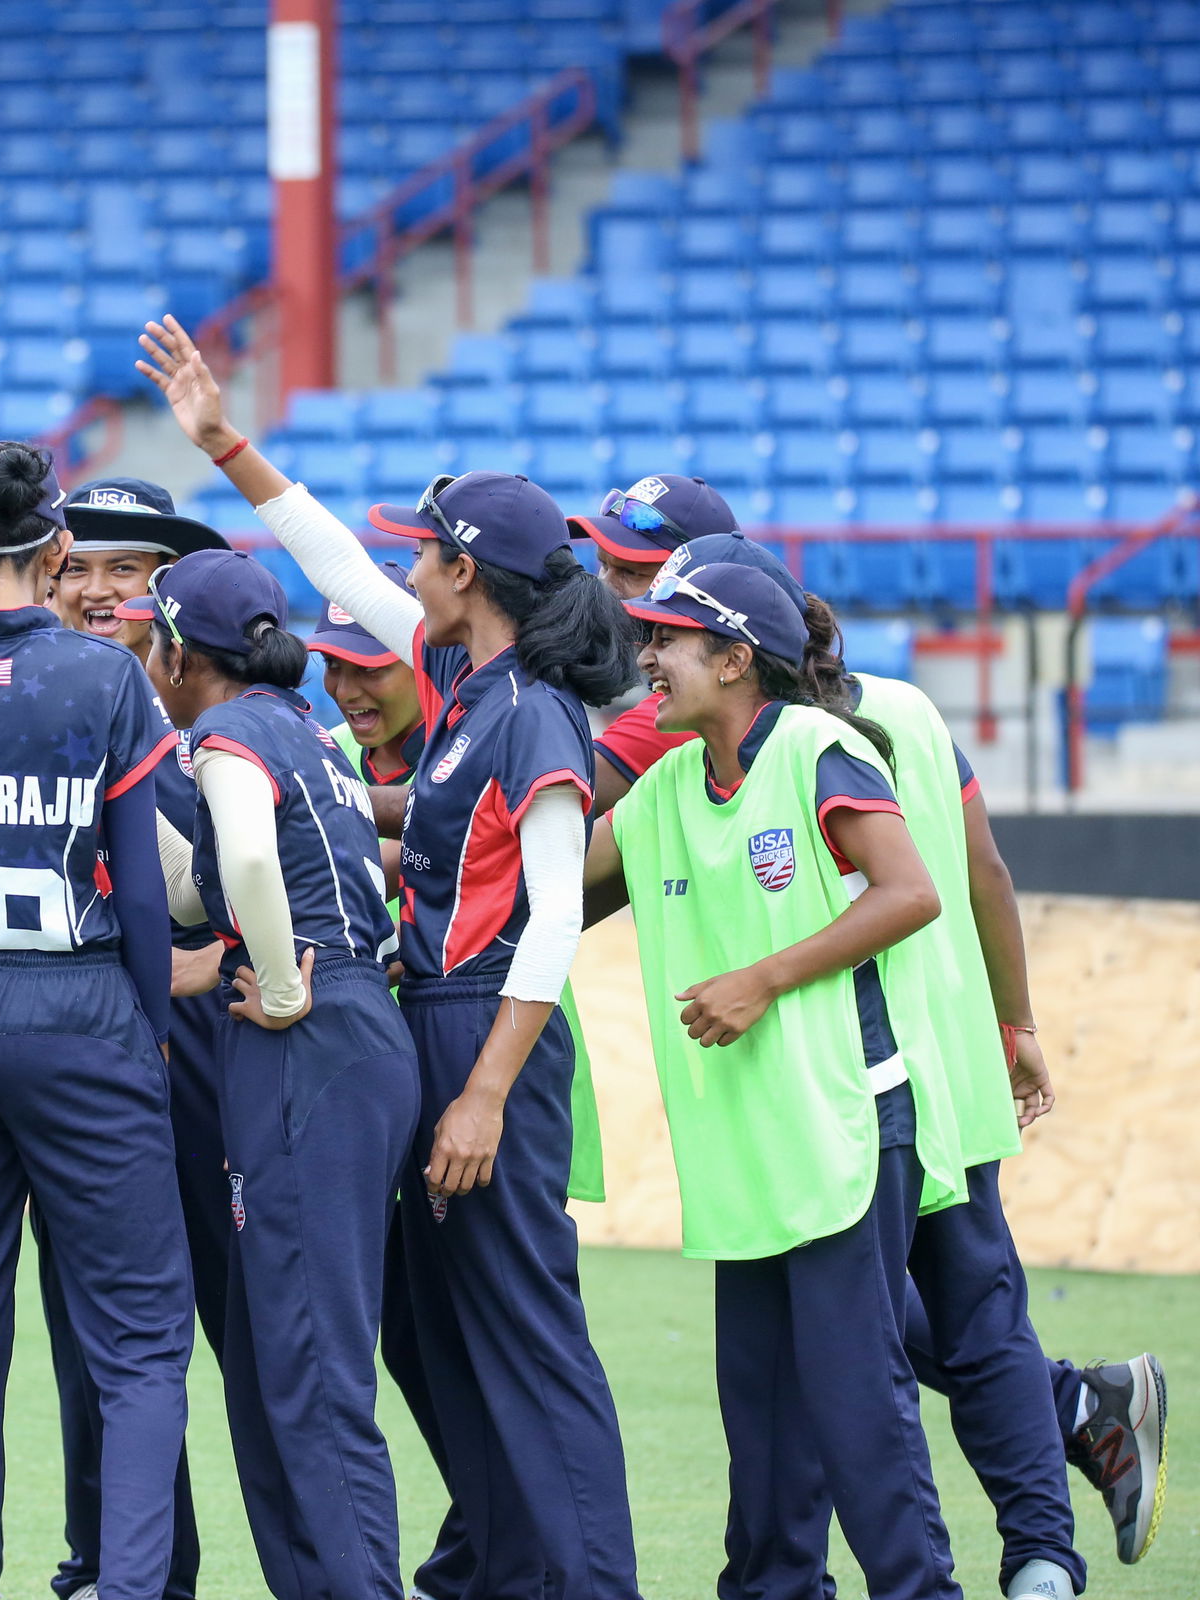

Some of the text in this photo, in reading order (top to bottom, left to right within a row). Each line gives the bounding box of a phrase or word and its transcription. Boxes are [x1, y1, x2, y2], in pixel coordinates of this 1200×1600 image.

[94, 492, 132, 505] USA
[751, 830, 791, 854] USA
[752, 848, 792, 865] CRICKET
